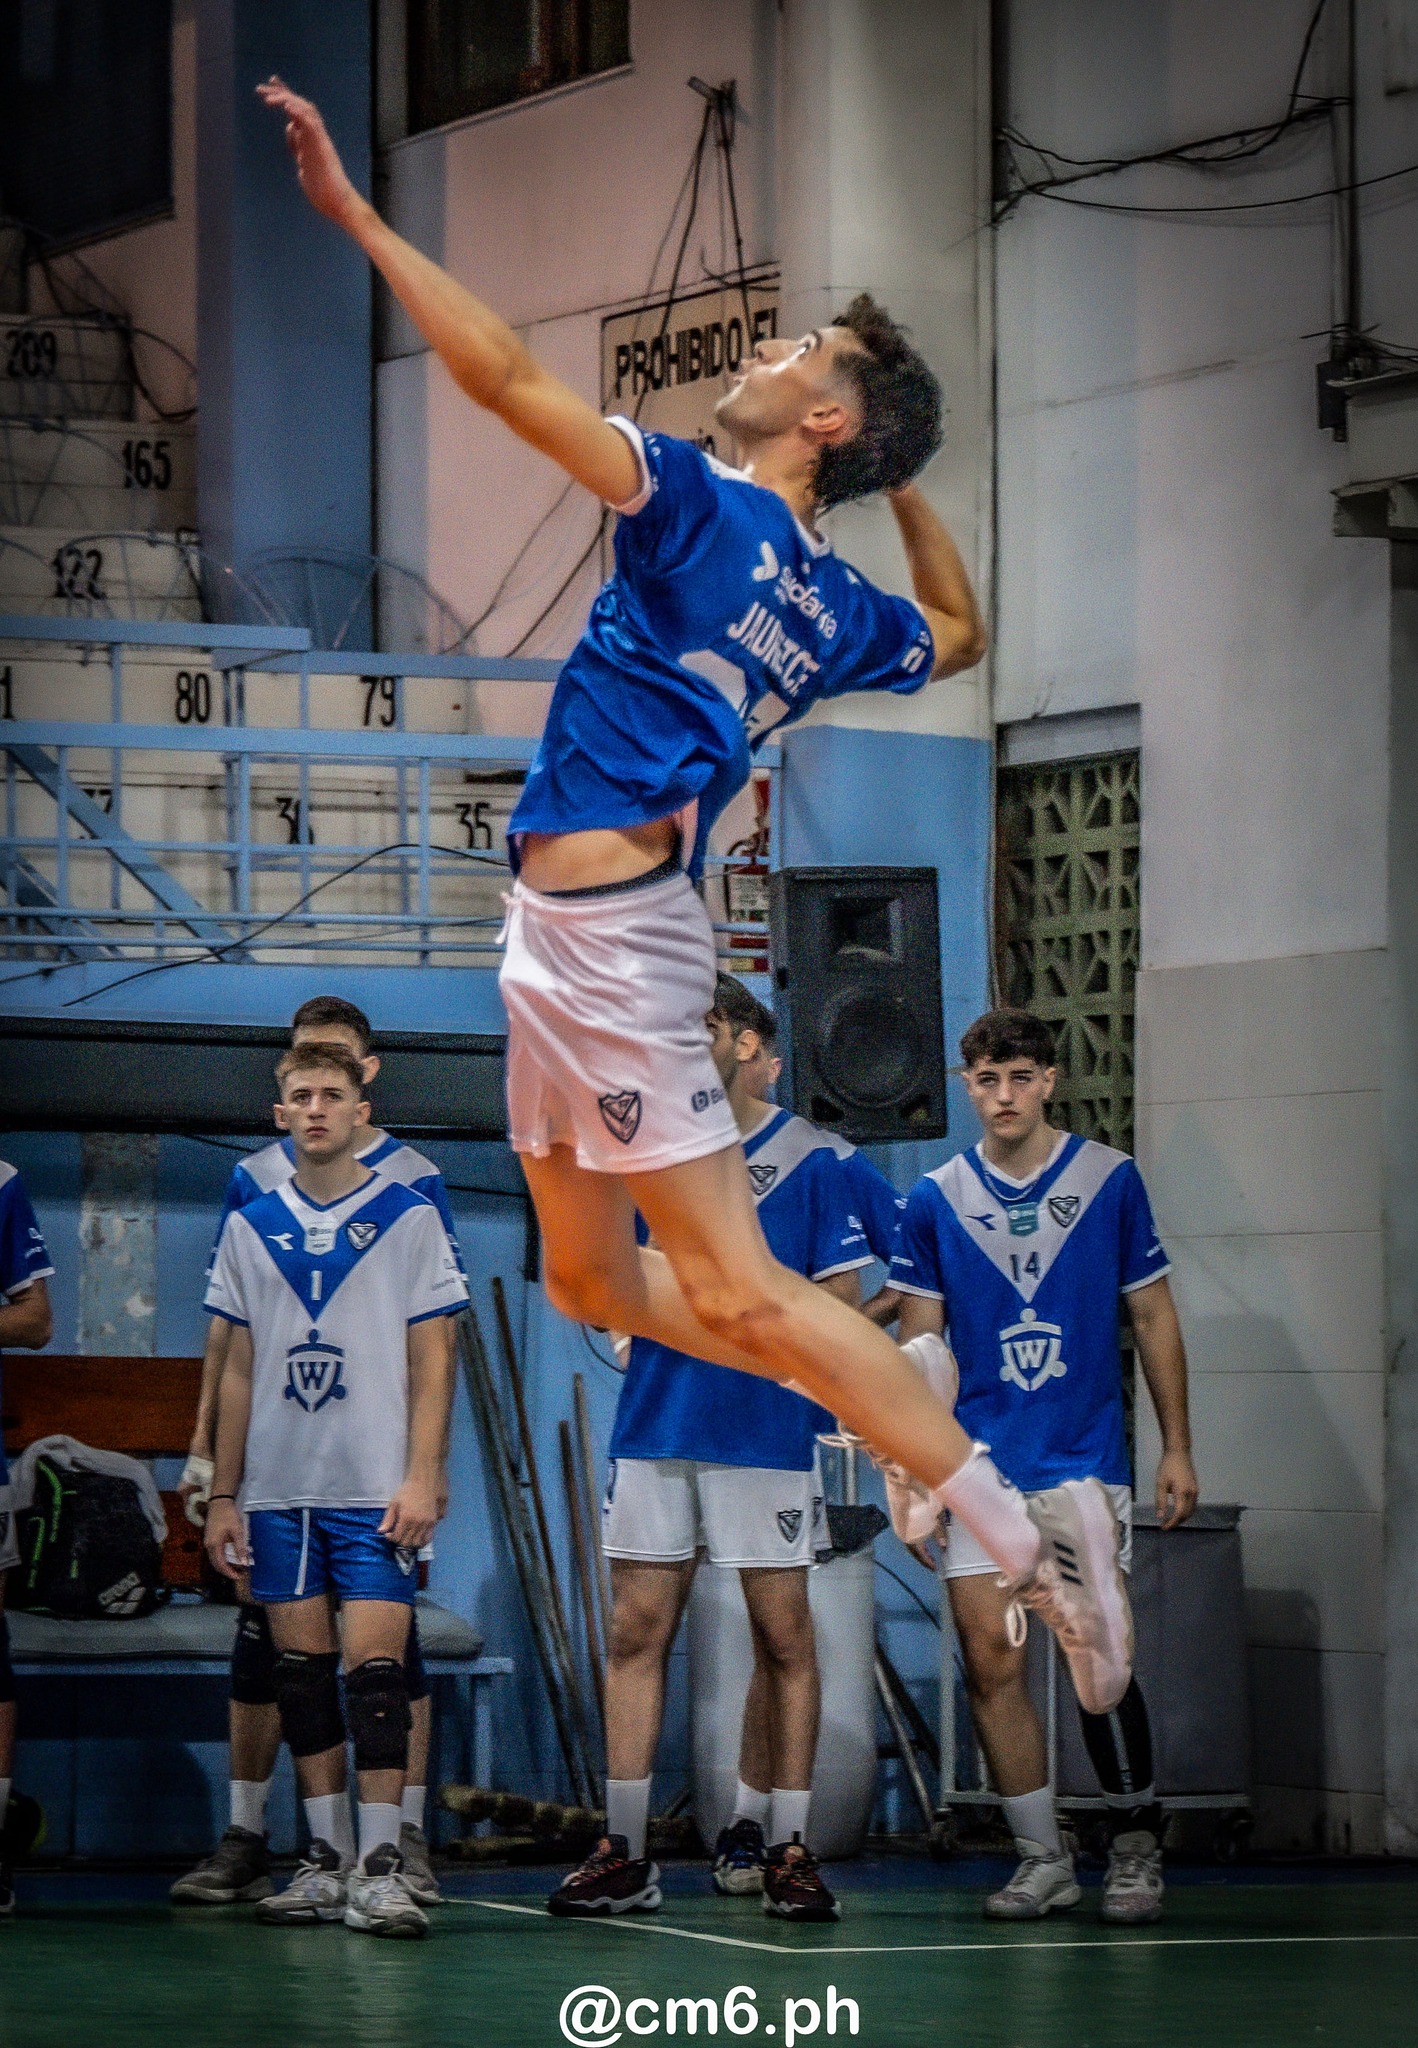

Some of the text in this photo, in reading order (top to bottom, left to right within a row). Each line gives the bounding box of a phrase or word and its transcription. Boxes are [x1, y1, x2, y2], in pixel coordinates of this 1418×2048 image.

[615, 317, 742, 399] PROHIBIDO
[122, 440, 172, 490] 165
[53, 548, 105, 600] 122
[176, 671, 210, 723] 80
[359, 674, 396, 727] 79
[454, 802, 492, 849] 35
[1010, 1252, 1040, 1283] 14
[295, 1362, 330, 1391] W
[1011, 1338, 1048, 1369] W
